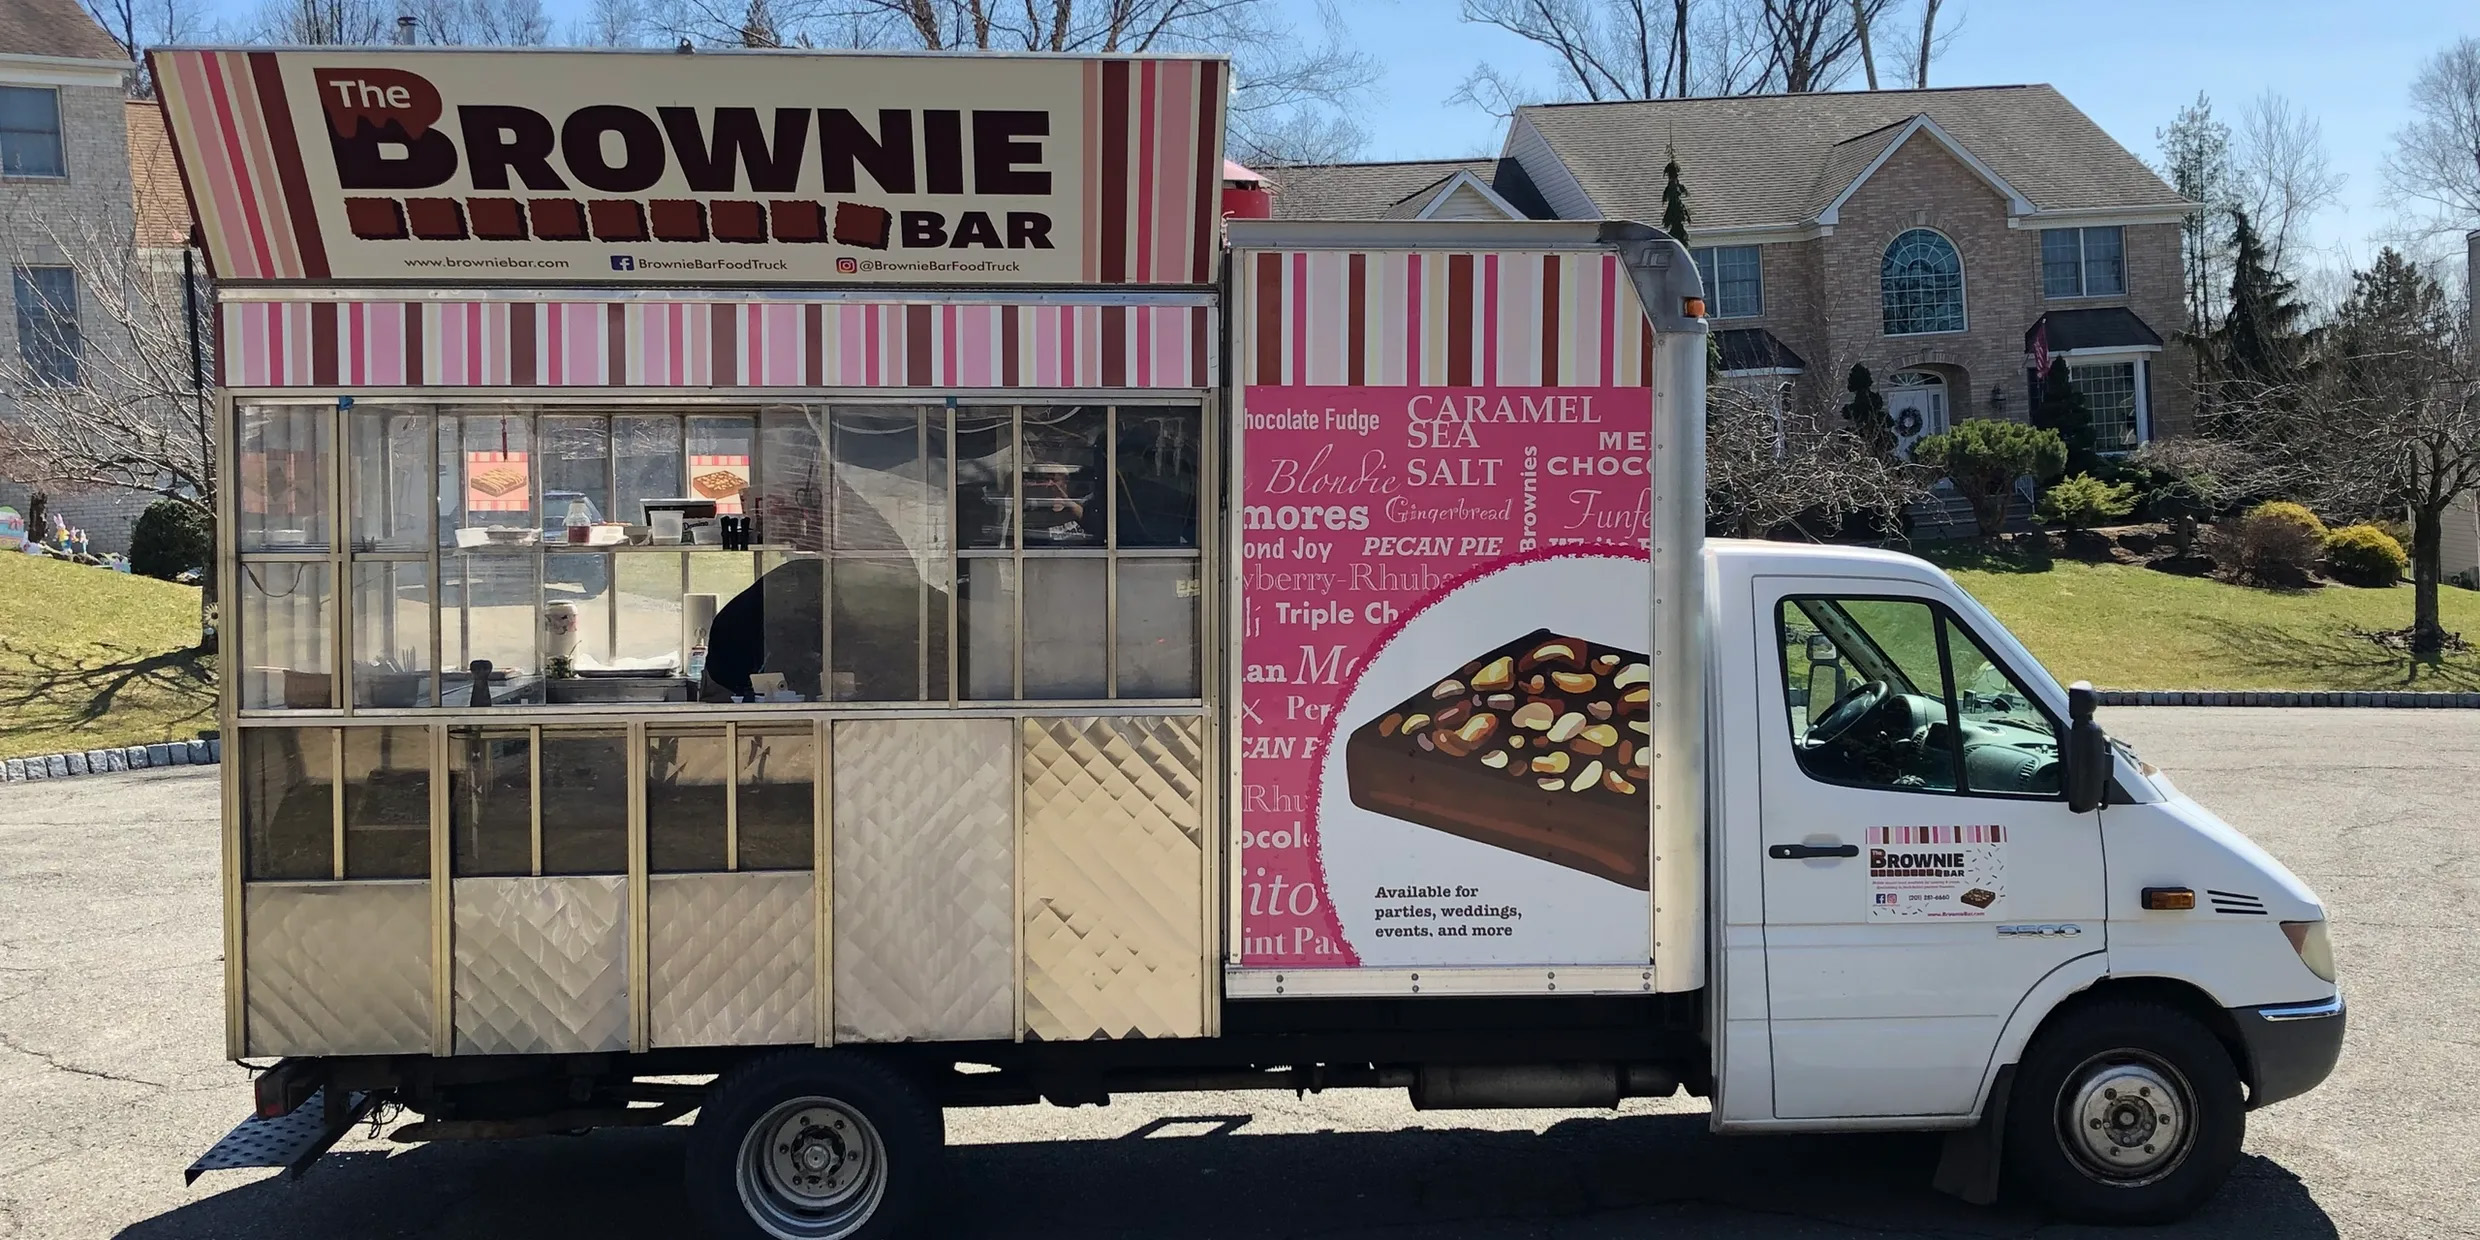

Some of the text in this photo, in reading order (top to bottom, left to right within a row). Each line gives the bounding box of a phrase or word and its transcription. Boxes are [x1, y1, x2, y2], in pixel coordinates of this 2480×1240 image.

[329, 79, 412, 109] The
[313, 67, 1053, 196] BROWNIE
[900, 210, 1056, 249] BAR
[404, 256, 570, 269] www.browniebar.com
[638, 258, 788, 271] BrownieBarFoodTruck
[859, 259, 1020, 273] @BrownieBarFoodTruck
[1244, 408, 1380, 436] hocolate Fudge
[1407, 395, 1602, 423] CARAMEL
[1407, 420, 1480, 448] SEA
[1599, 431, 1651, 451] ME
[1265, 444, 1401, 494] Blondie
[1407, 458, 1503, 486] SALT
[1547, 456, 1651, 476] CHOC
[1385, 495, 1512, 524] Gingerbread
[1519, 445, 1538, 553] Brownies
[1244, 504, 1370, 531] mores
[1244, 536, 1332, 563] ond Joy
[1362, 537, 1503, 556] PECAN PIE
[1276, 601, 1399, 631] Triple Ch
[1870, 848, 1965, 868] BROWNIE
[1943, 869, 1965, 877] BAR
[1375, 885, 1479, 898] Available for
[1375, 904, 1523, 921] parties, weddings,
[1438, 925, 1468, 937] and
[1472, 926, 1513, 937] more
